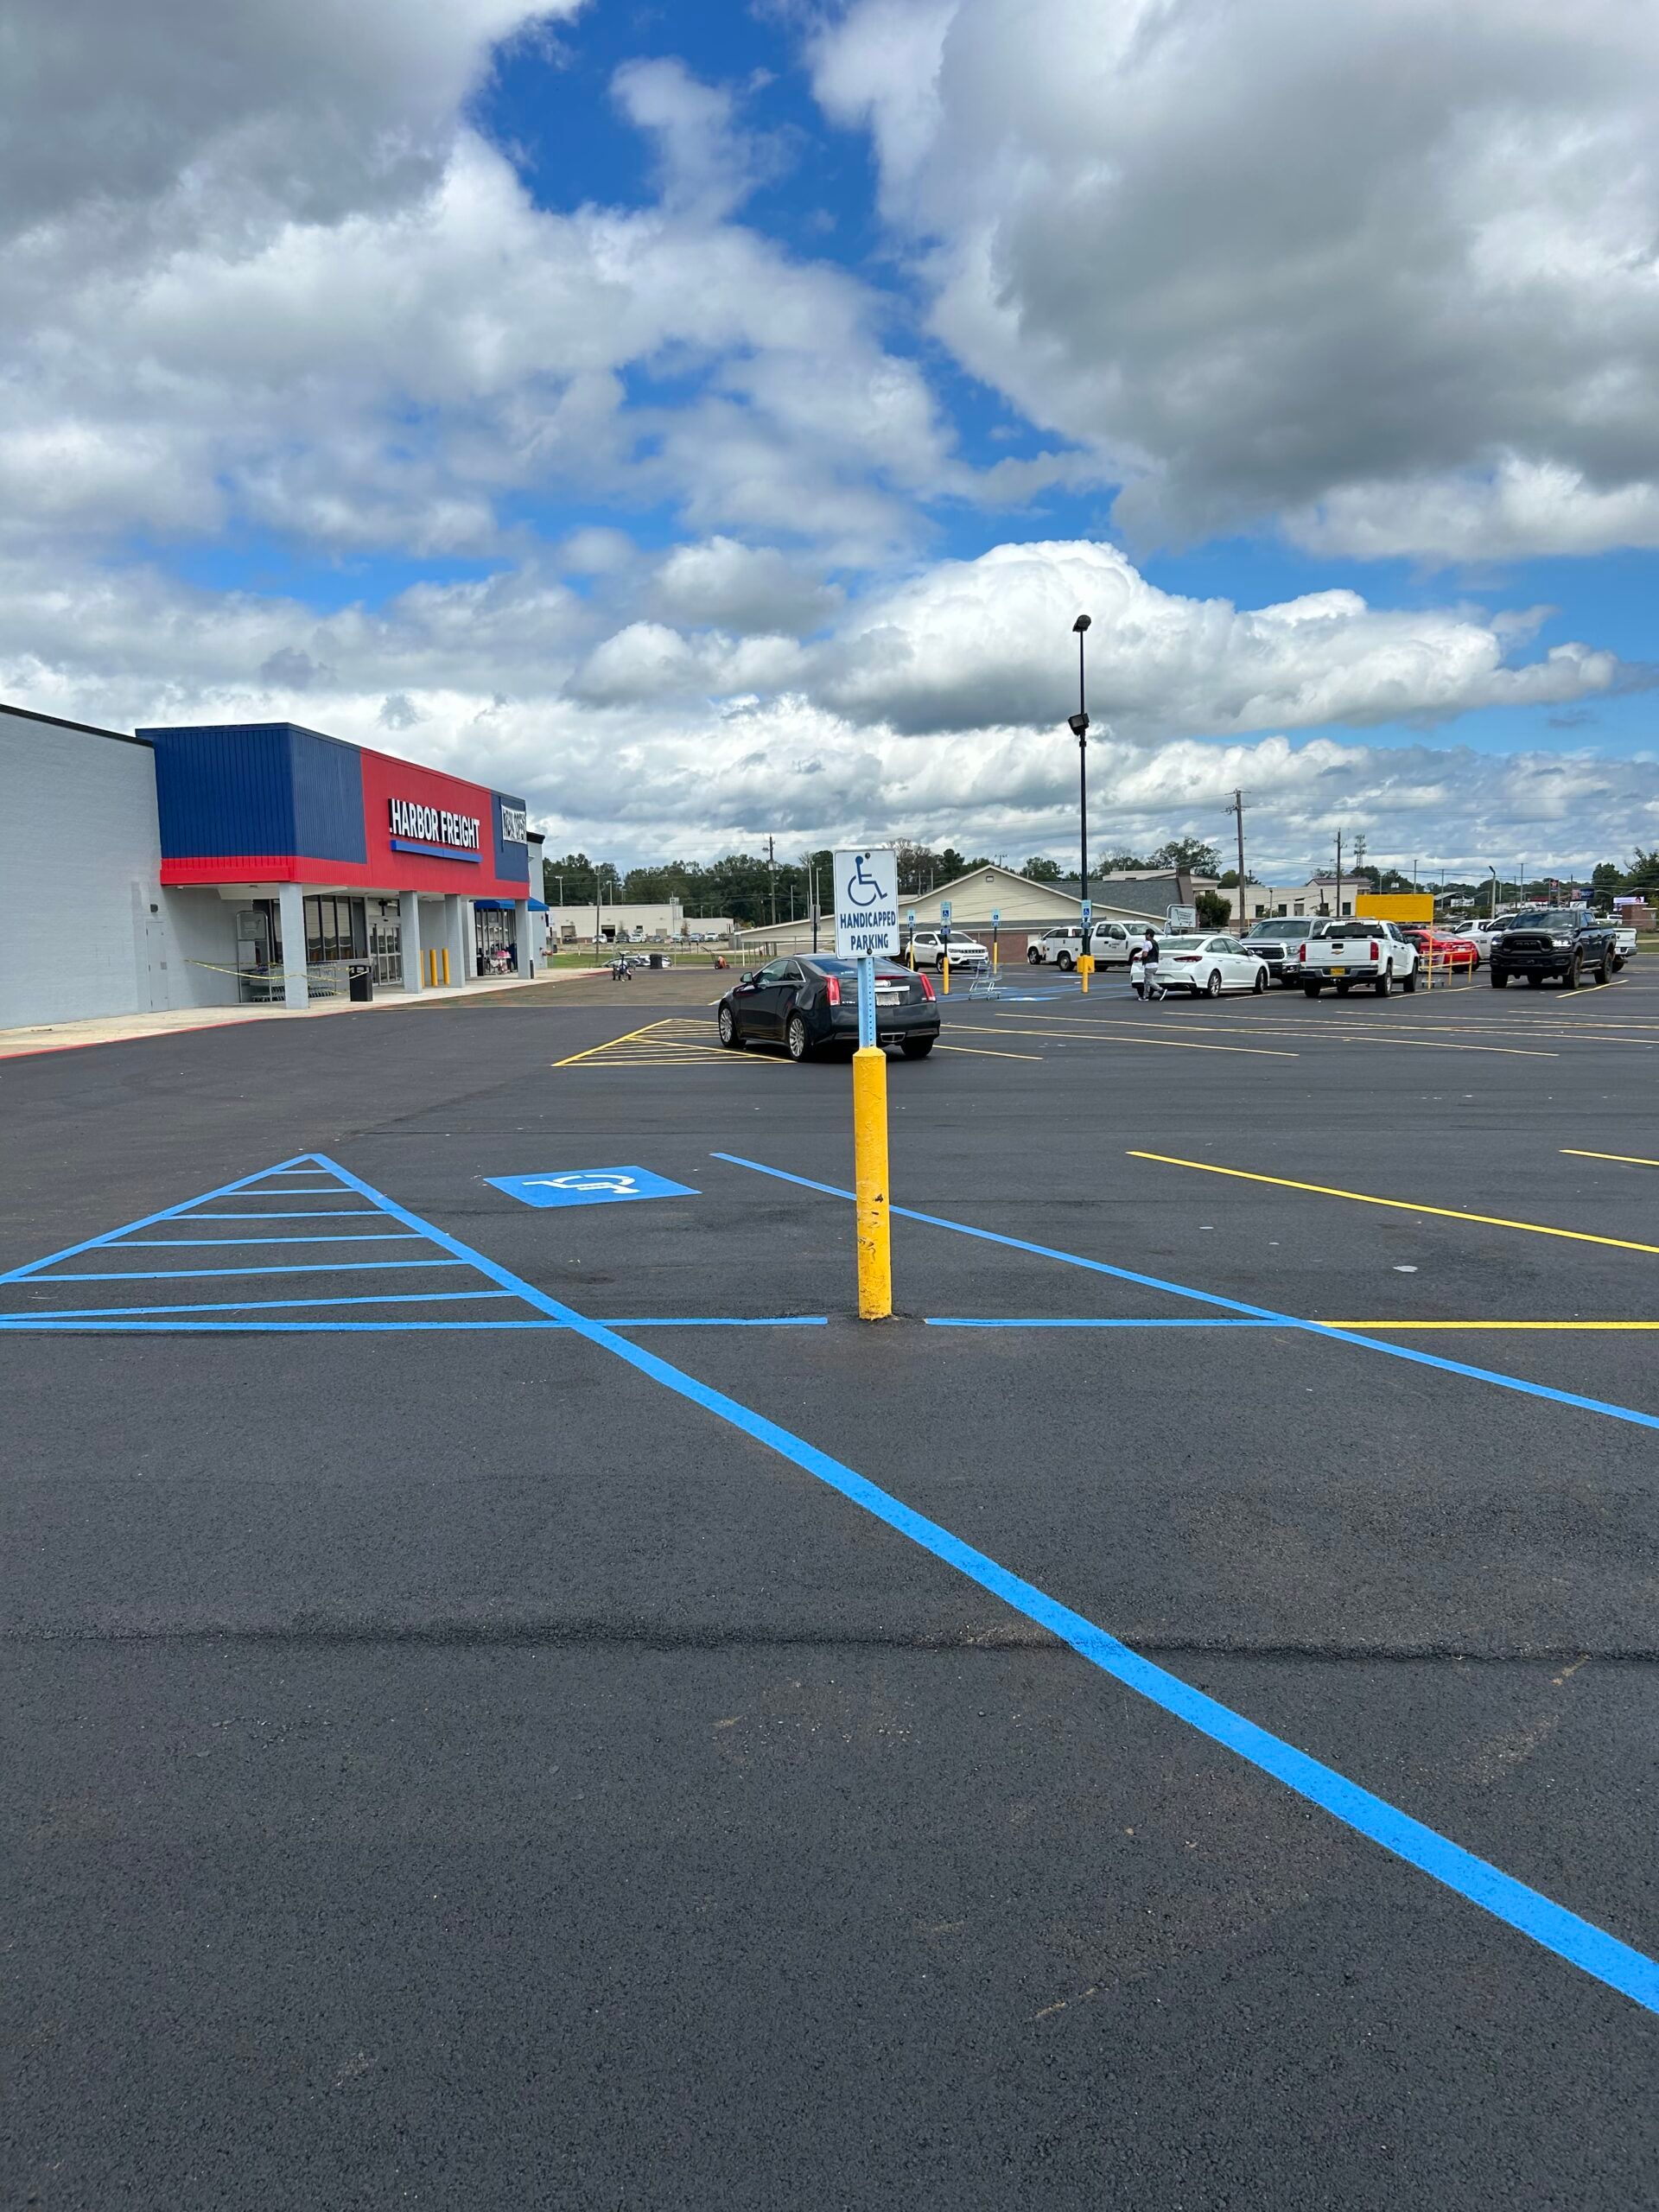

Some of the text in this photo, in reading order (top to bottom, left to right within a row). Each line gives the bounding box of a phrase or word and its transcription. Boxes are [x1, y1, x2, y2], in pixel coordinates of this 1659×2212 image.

[391, 798, 439, 842] HARBOR
[440, 810, 480, 849] FREIGHT
[840, 911, 896, 929] HANDICAPPED
[850, 933, 888, 950] PARKING
